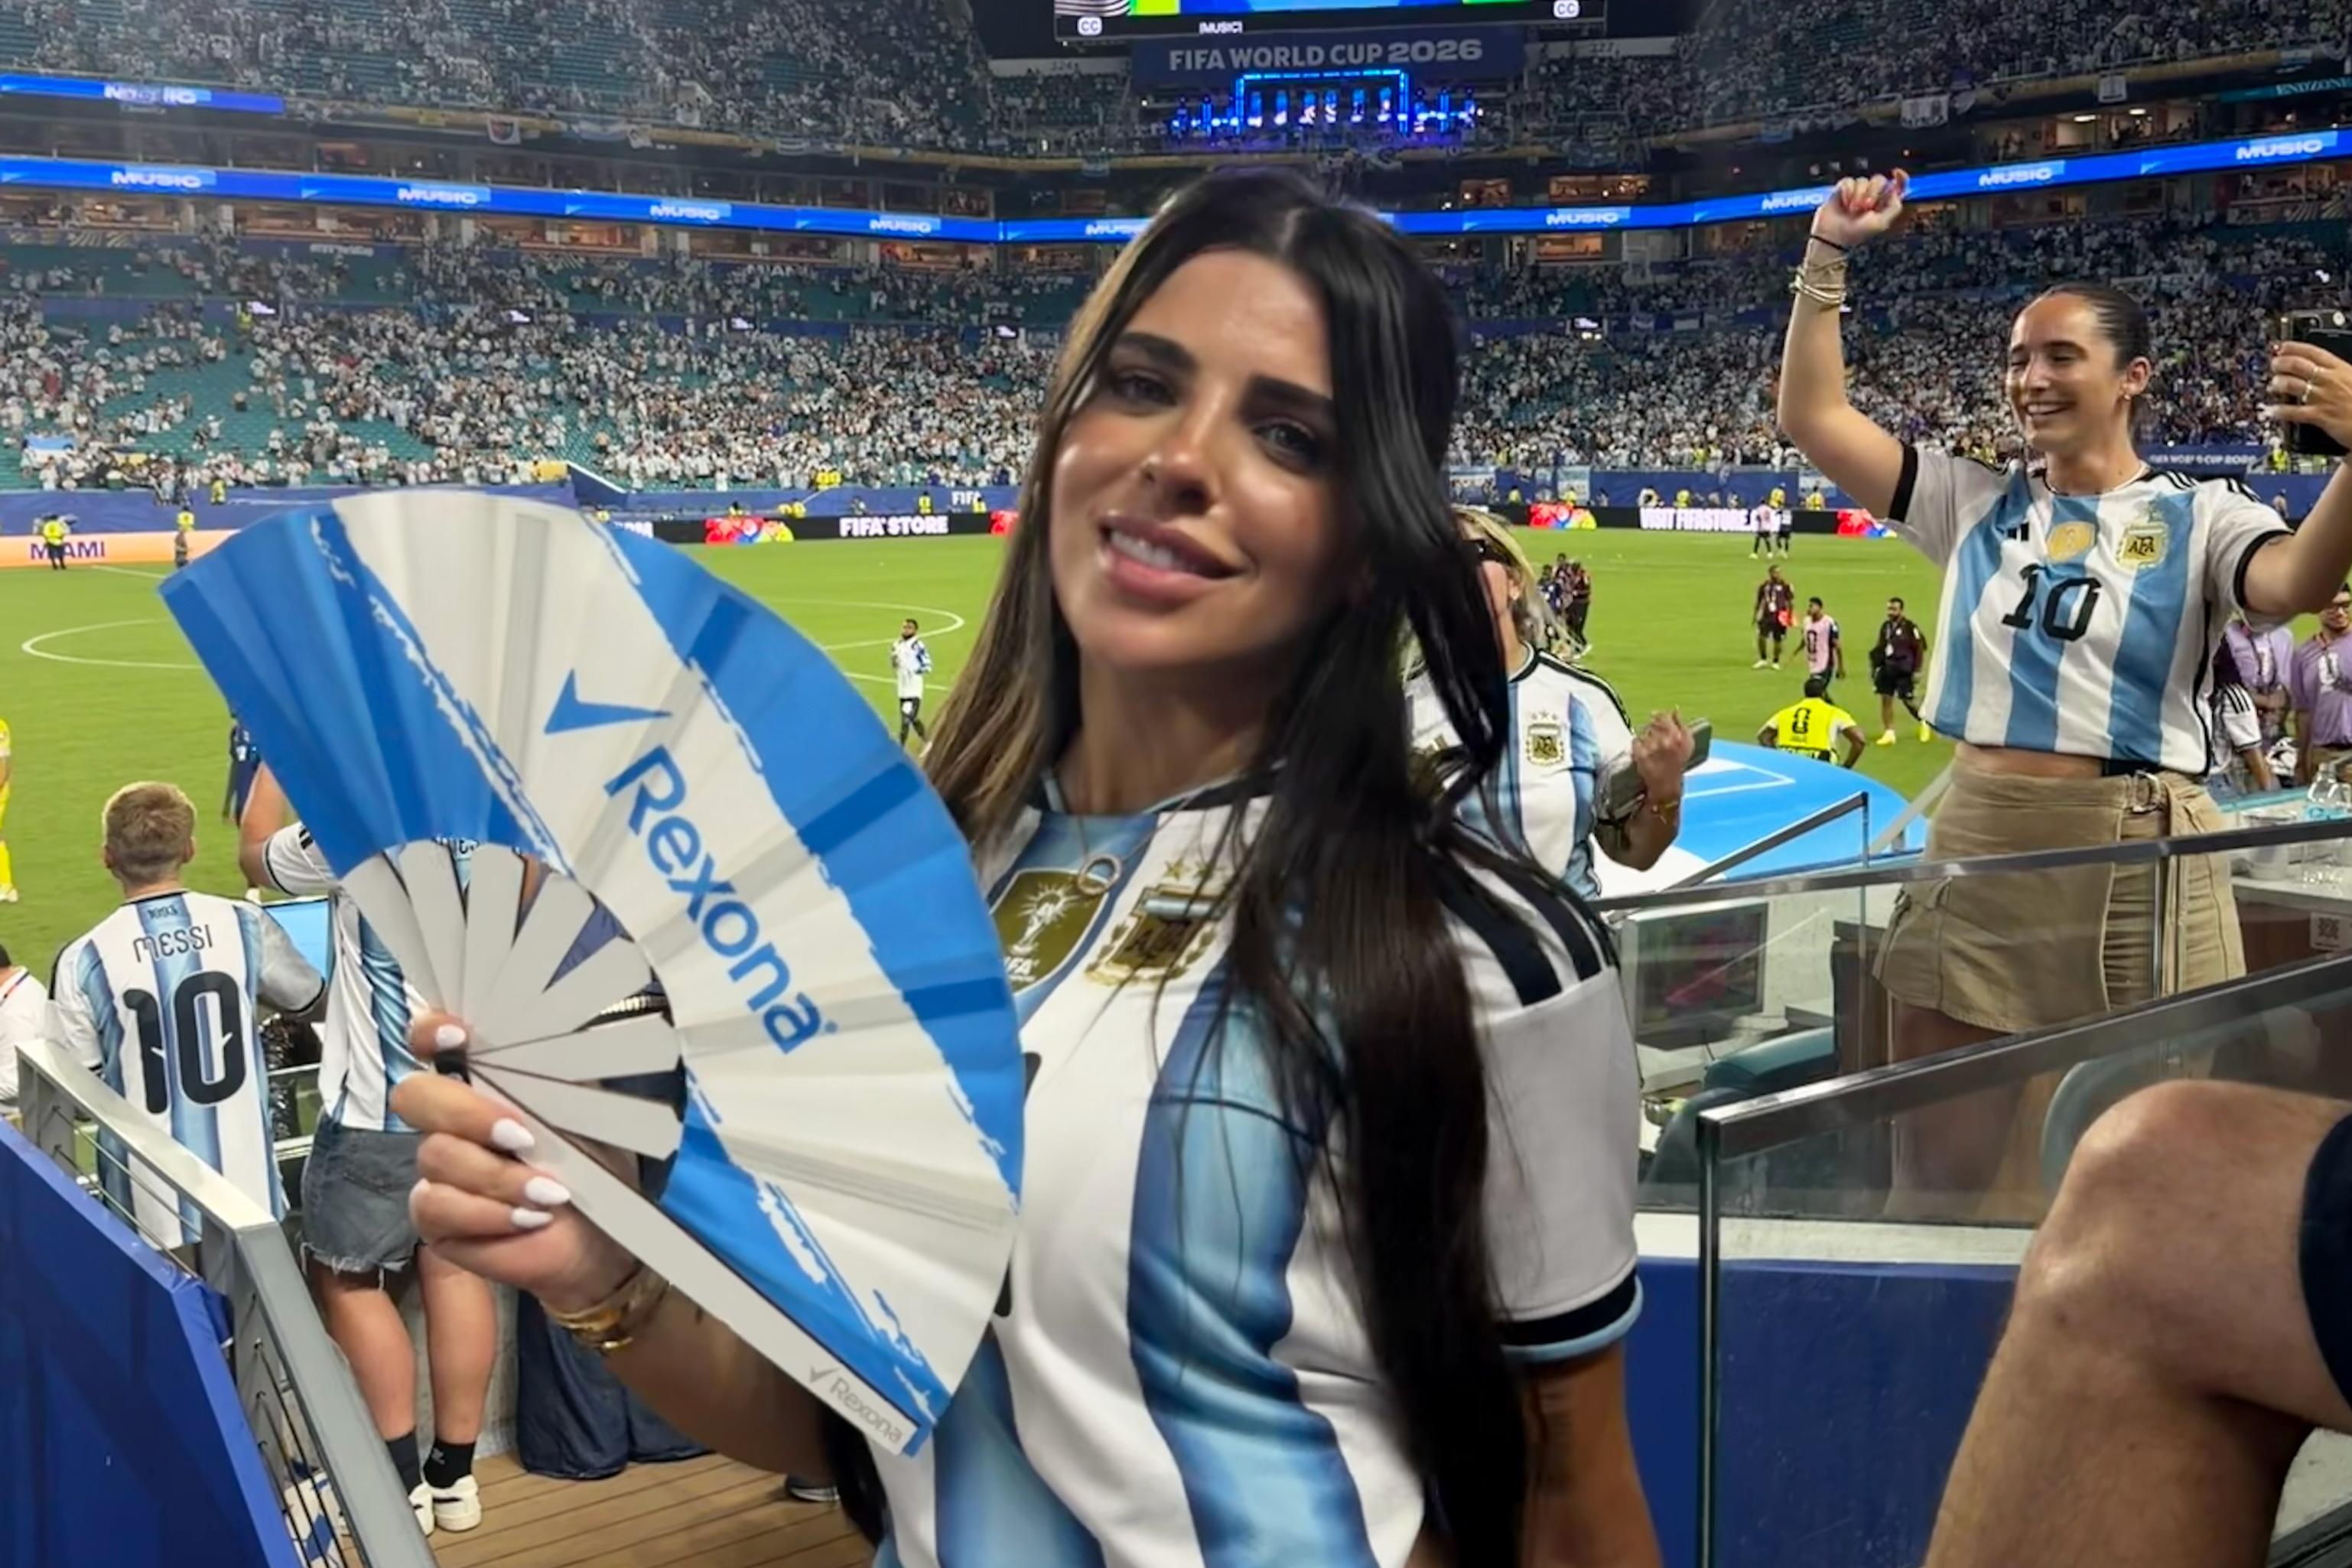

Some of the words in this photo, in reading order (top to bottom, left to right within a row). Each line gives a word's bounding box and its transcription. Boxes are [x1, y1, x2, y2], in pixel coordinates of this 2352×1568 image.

[1169, 49, 1225, 71] FIFA
[1230, 45, 1324, 69] WORLD
[1329, 44, 1383, 66] CUP
[1387, 40, 1482, 63] 2026
[2236, 140, 2323, 159] MUSIC
[111, 171, 202, 189] MUSIC
[1979, 168, 2052, 187] MUSIC
[398, 187, 478, 205] MUSIC
[649, 205, 720, 221] MUSIC
[1546, 213, 1618, 226] MUSIC
[870, 219, 932, 234] MUSIC
[840, 518, 885, 537] FIFA
[887, 516, 948, 535] STORE
[31, 541, 106, 560] MAMI
[2002, 564, 2102, 642] 10
[603, 745, 822, 1054] Rexona
[133, 924, 213, 963] MESSI
[123, 971, 246, 1115] 10
[830, 1377, 903, 1445] Rexona
